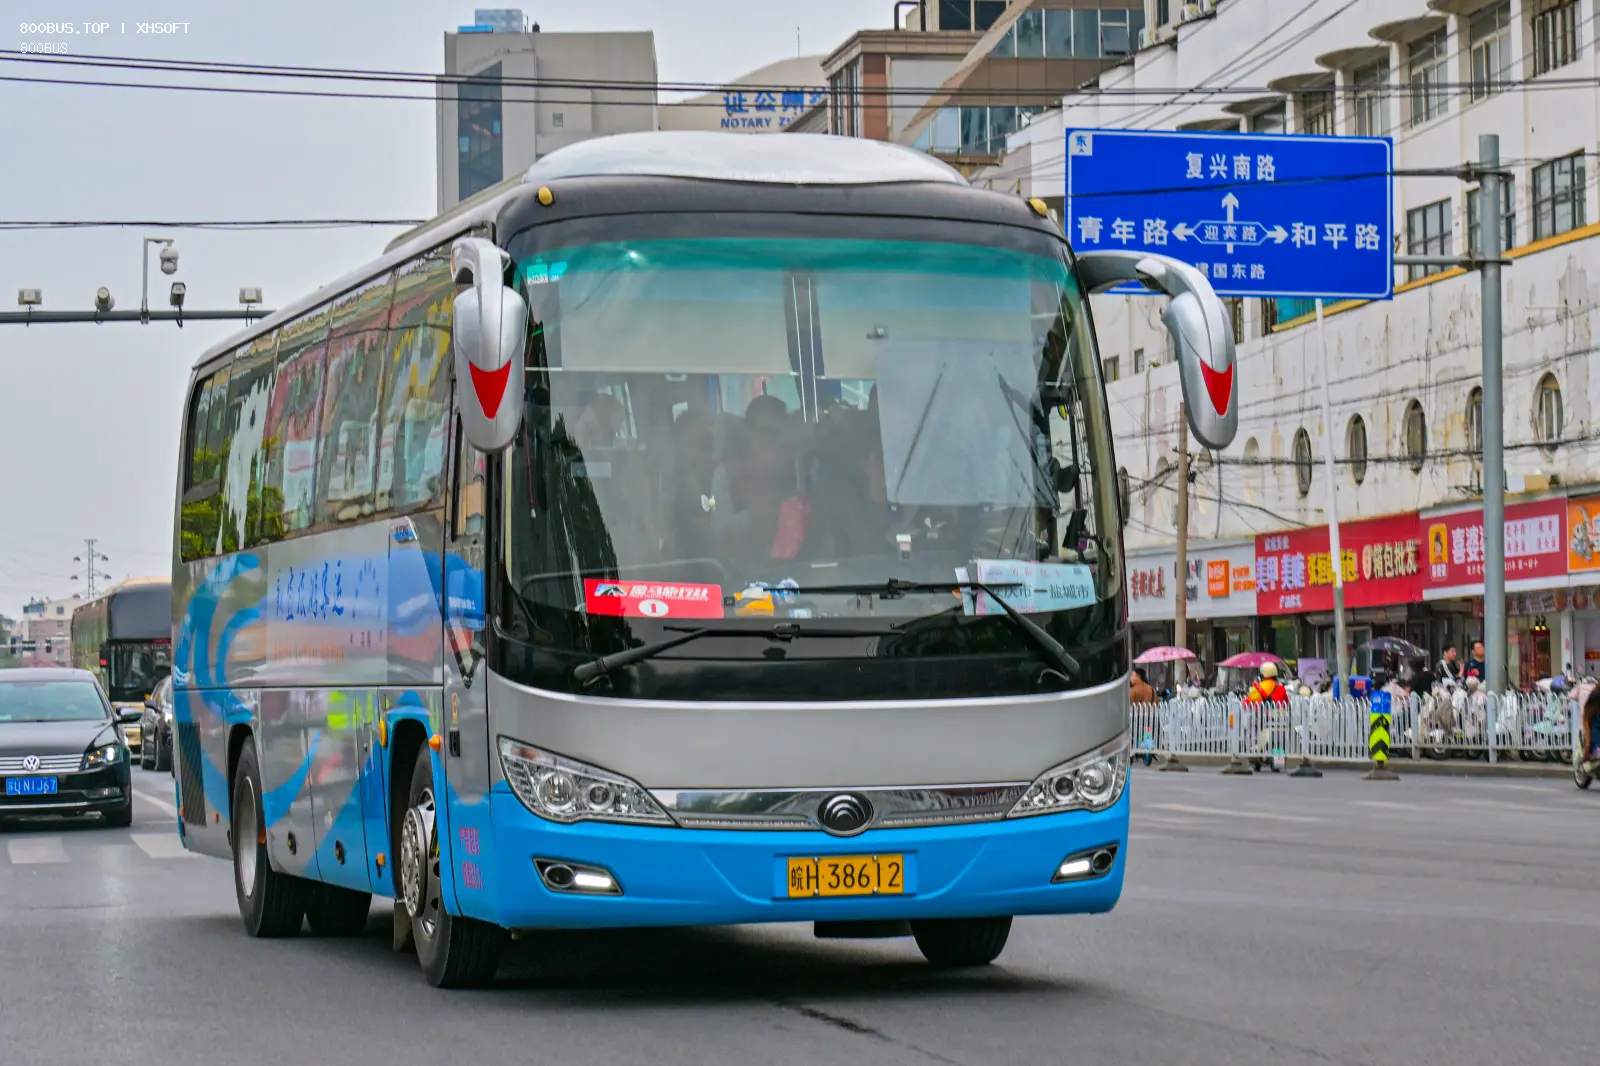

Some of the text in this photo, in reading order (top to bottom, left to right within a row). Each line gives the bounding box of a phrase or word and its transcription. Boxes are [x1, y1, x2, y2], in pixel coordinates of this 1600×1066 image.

[720, 117, 772, 129] NOTARY
[1076, 134, 1087, 147] 东
[1185, 151, 1276, 181] 复兴南路
[1077, 216, 1380, 251] 青年路 迎宾路 和平路
[1451, 525, 1484, 565] 喜婆
